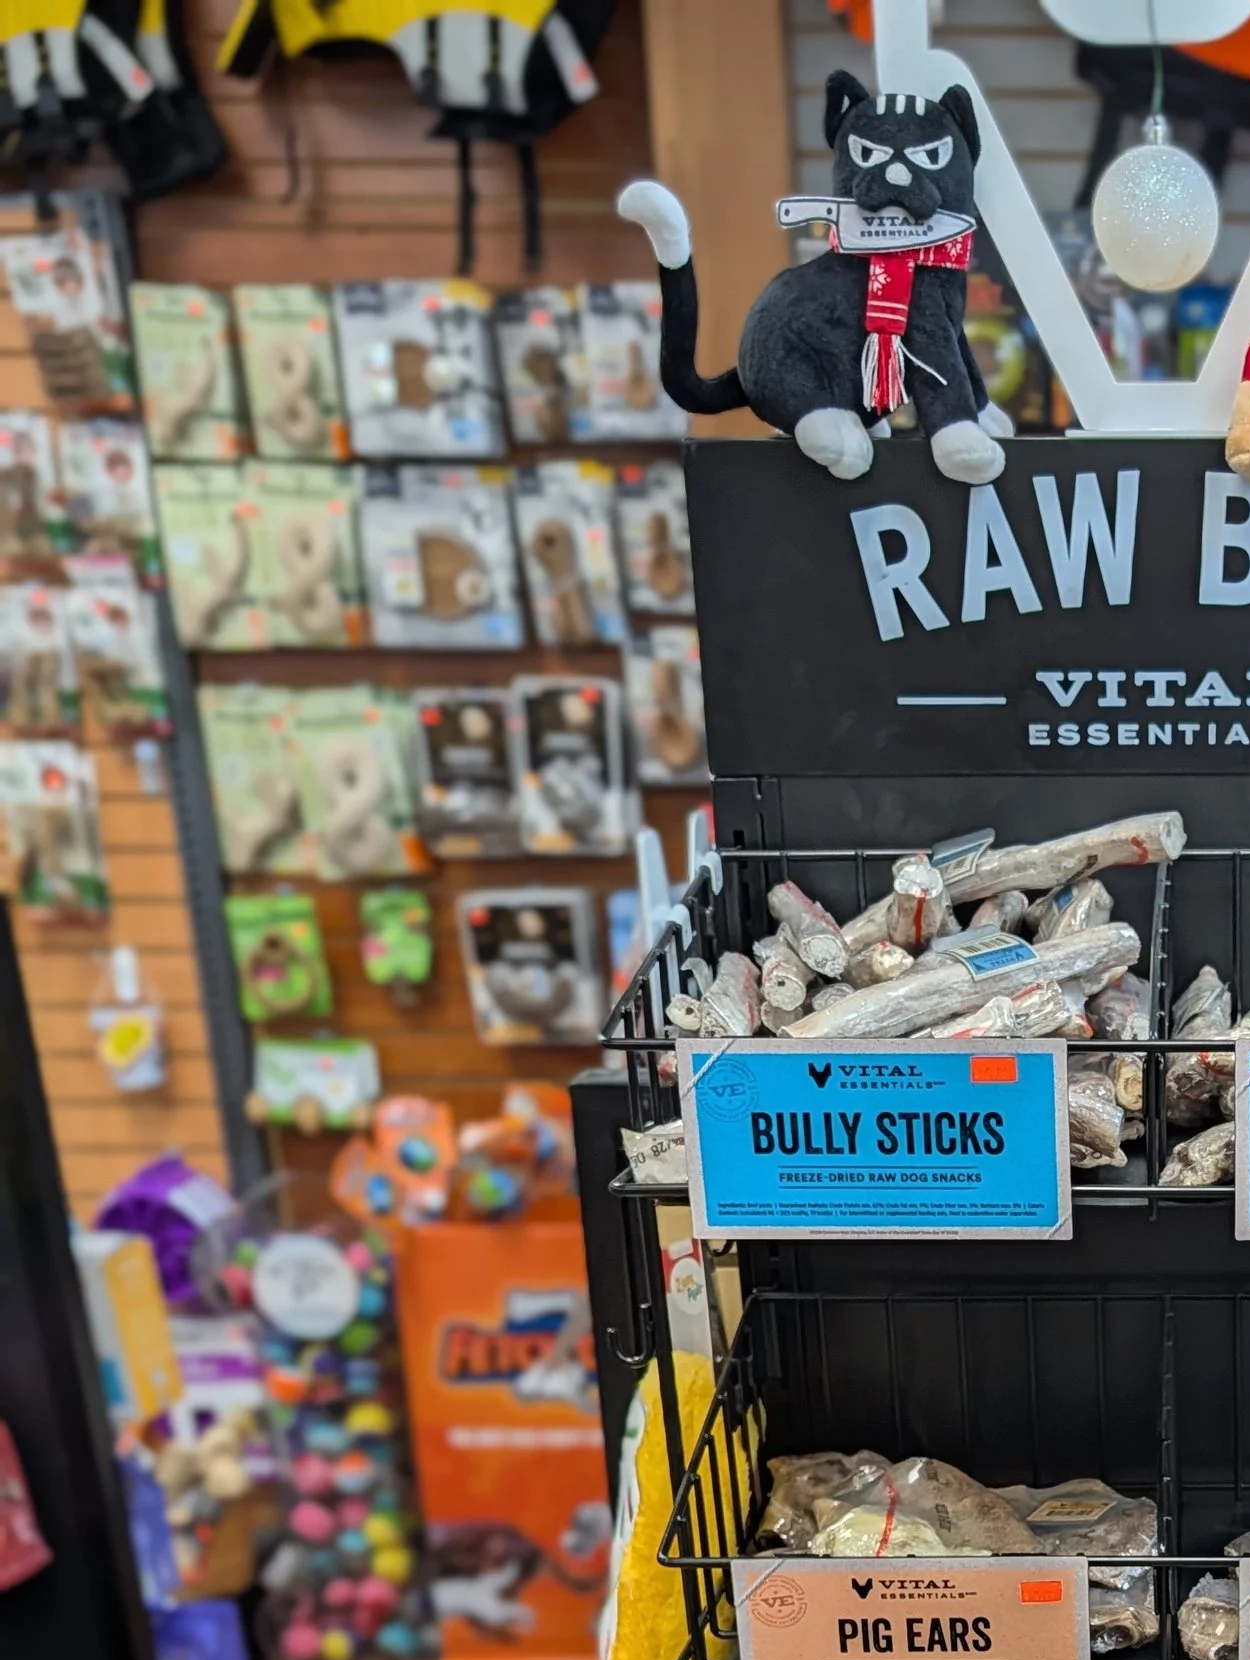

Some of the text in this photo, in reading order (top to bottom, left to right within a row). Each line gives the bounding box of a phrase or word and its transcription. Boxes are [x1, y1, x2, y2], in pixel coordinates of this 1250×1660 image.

[850, 469, 1141, 641] RAW
[838, 1065, 923, 1077] VITAL
[750, 1112, 1006, 1155] BULLY STICKS
[778, 1172, 982, 1184] FREEZE-DRIED RAW DOG SNACKS
[878, 1579, 956, 1590] VITAL
[838, 1616, 992, 1653] PIG EARS
